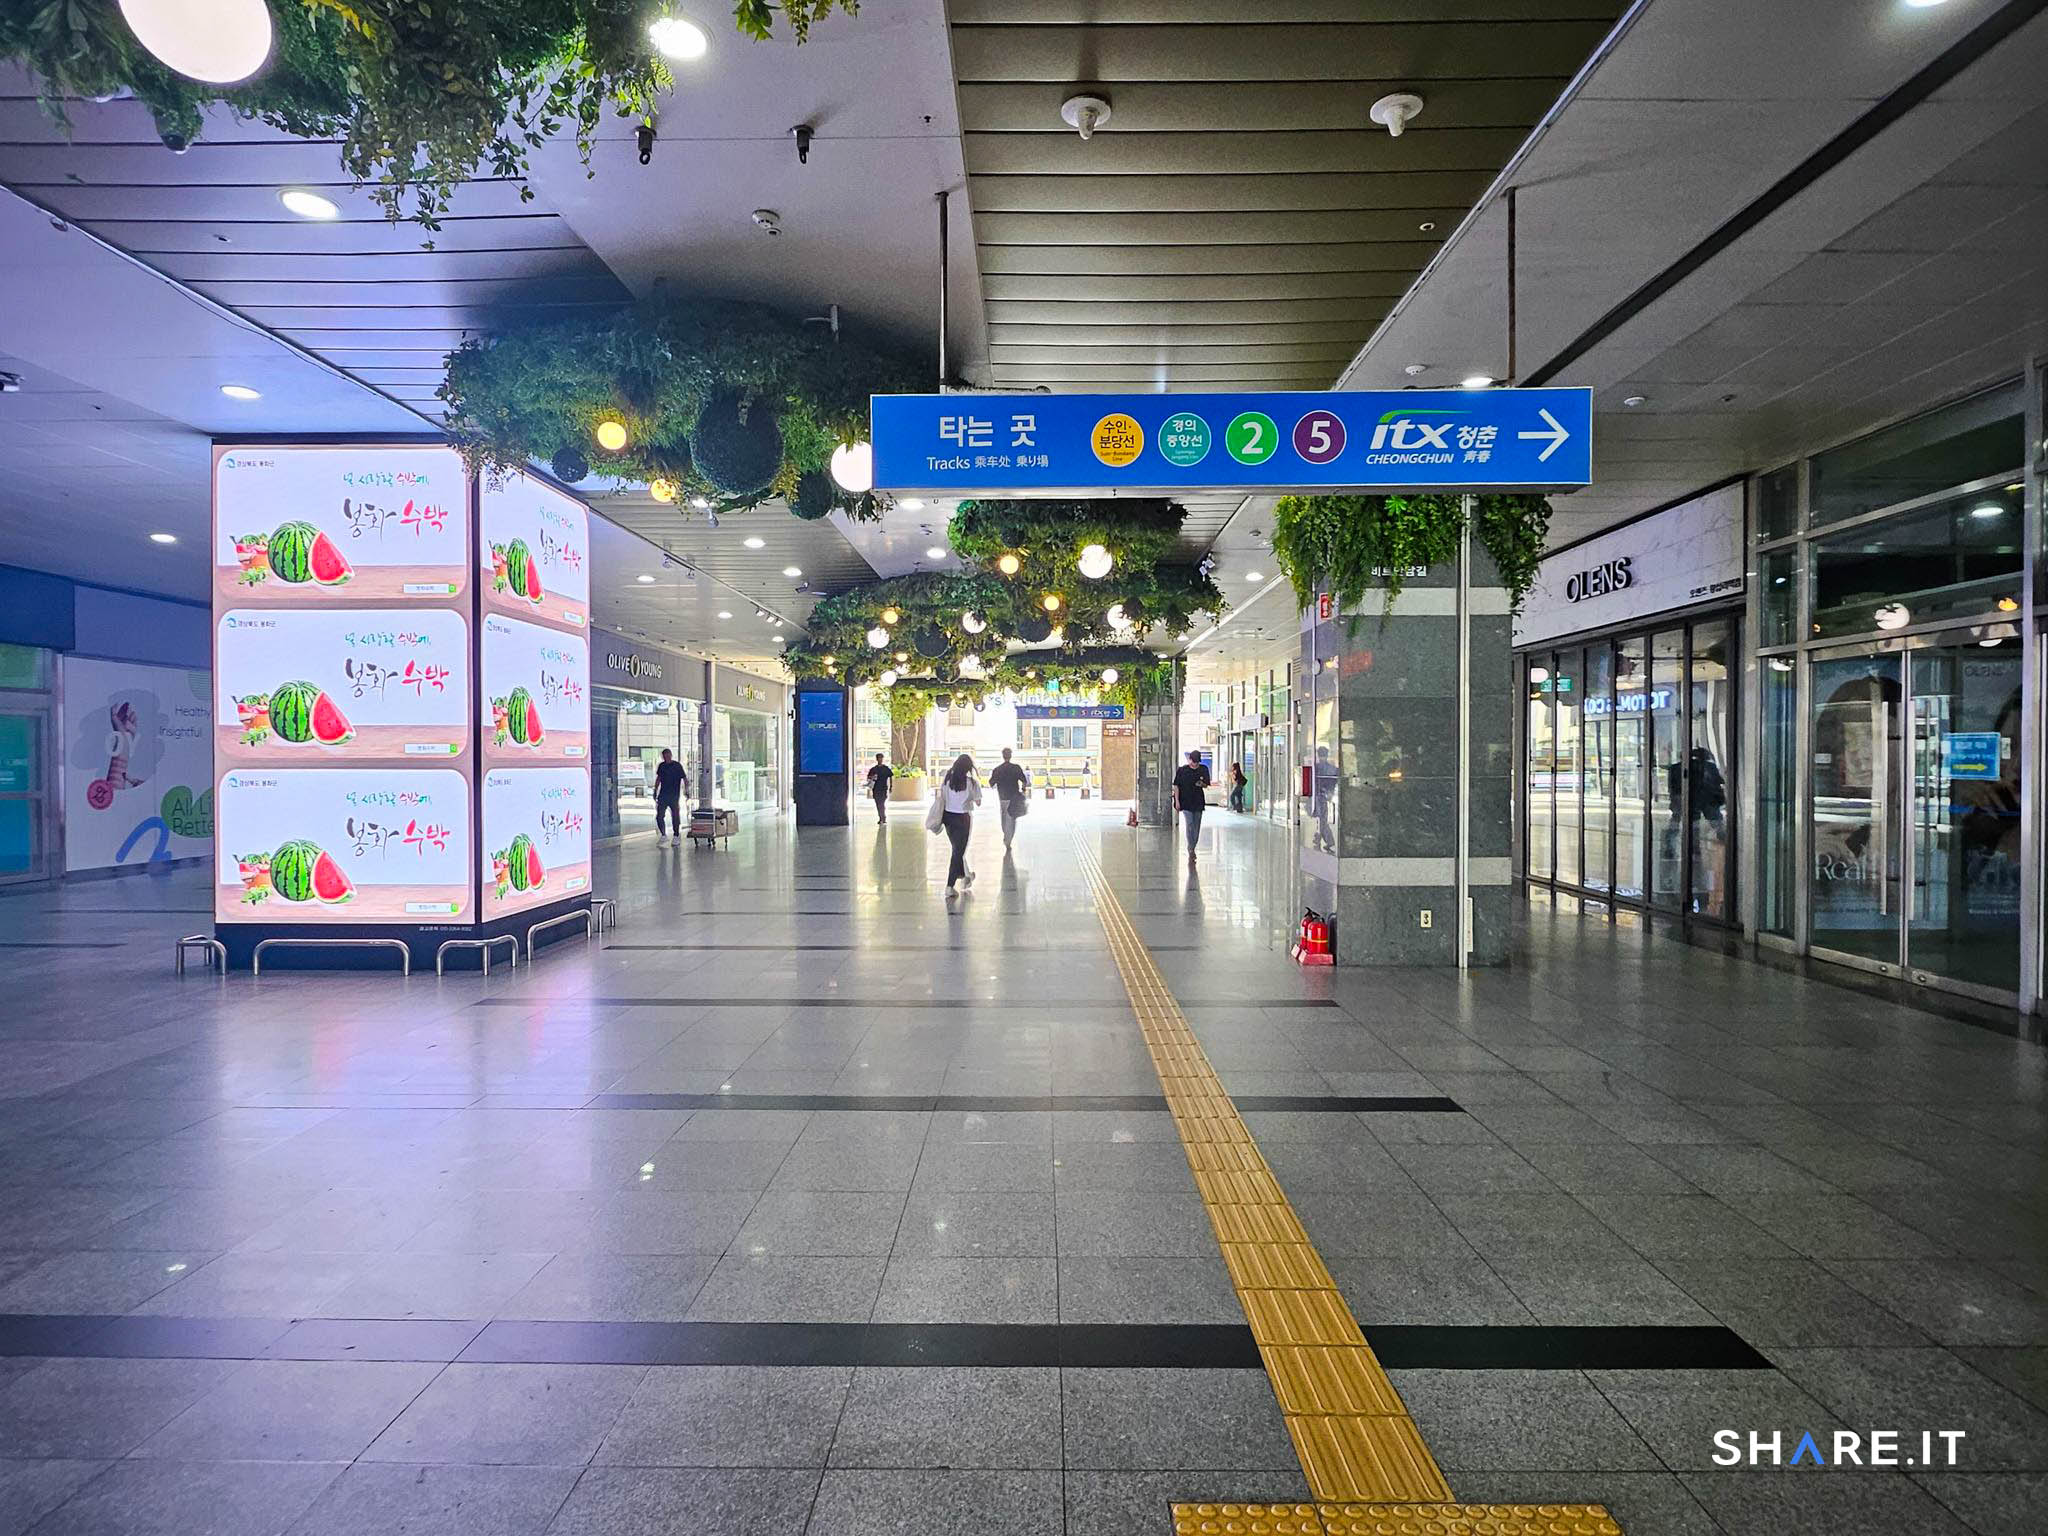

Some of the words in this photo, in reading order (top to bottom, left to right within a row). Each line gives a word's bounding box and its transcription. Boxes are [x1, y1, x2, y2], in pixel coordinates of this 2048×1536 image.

[939, 415, 994, 448] 타는
[1010, 414, 1037, 447] 곳
[1172, 419, 1197, 433] 경의
[1241, 421, 1264, 455] 2
[1308, 420, 1331, 454] 5
[1456, 425, 1499, 449] 청춘
[1099, 434, 1135, 449] 분당선
[1166, 434, 1203, 448] 중앙선
[926, 456, 971, 470] Tracks
[1366, 453, 1454, 465] CHEONGCHUN
[400, 499, 448, 538] 수박
[1566, 557, 1632, 603] OLENS
[401, 659, 450, 696] 수박
[608, 653, 630, 672] OLIVE
[640, 660, 662, 679] YOUNG
[160, 725, 202, 740] Insightful
[171, 797, 193, 817] All
[403, 819, 451, 856] 수박
